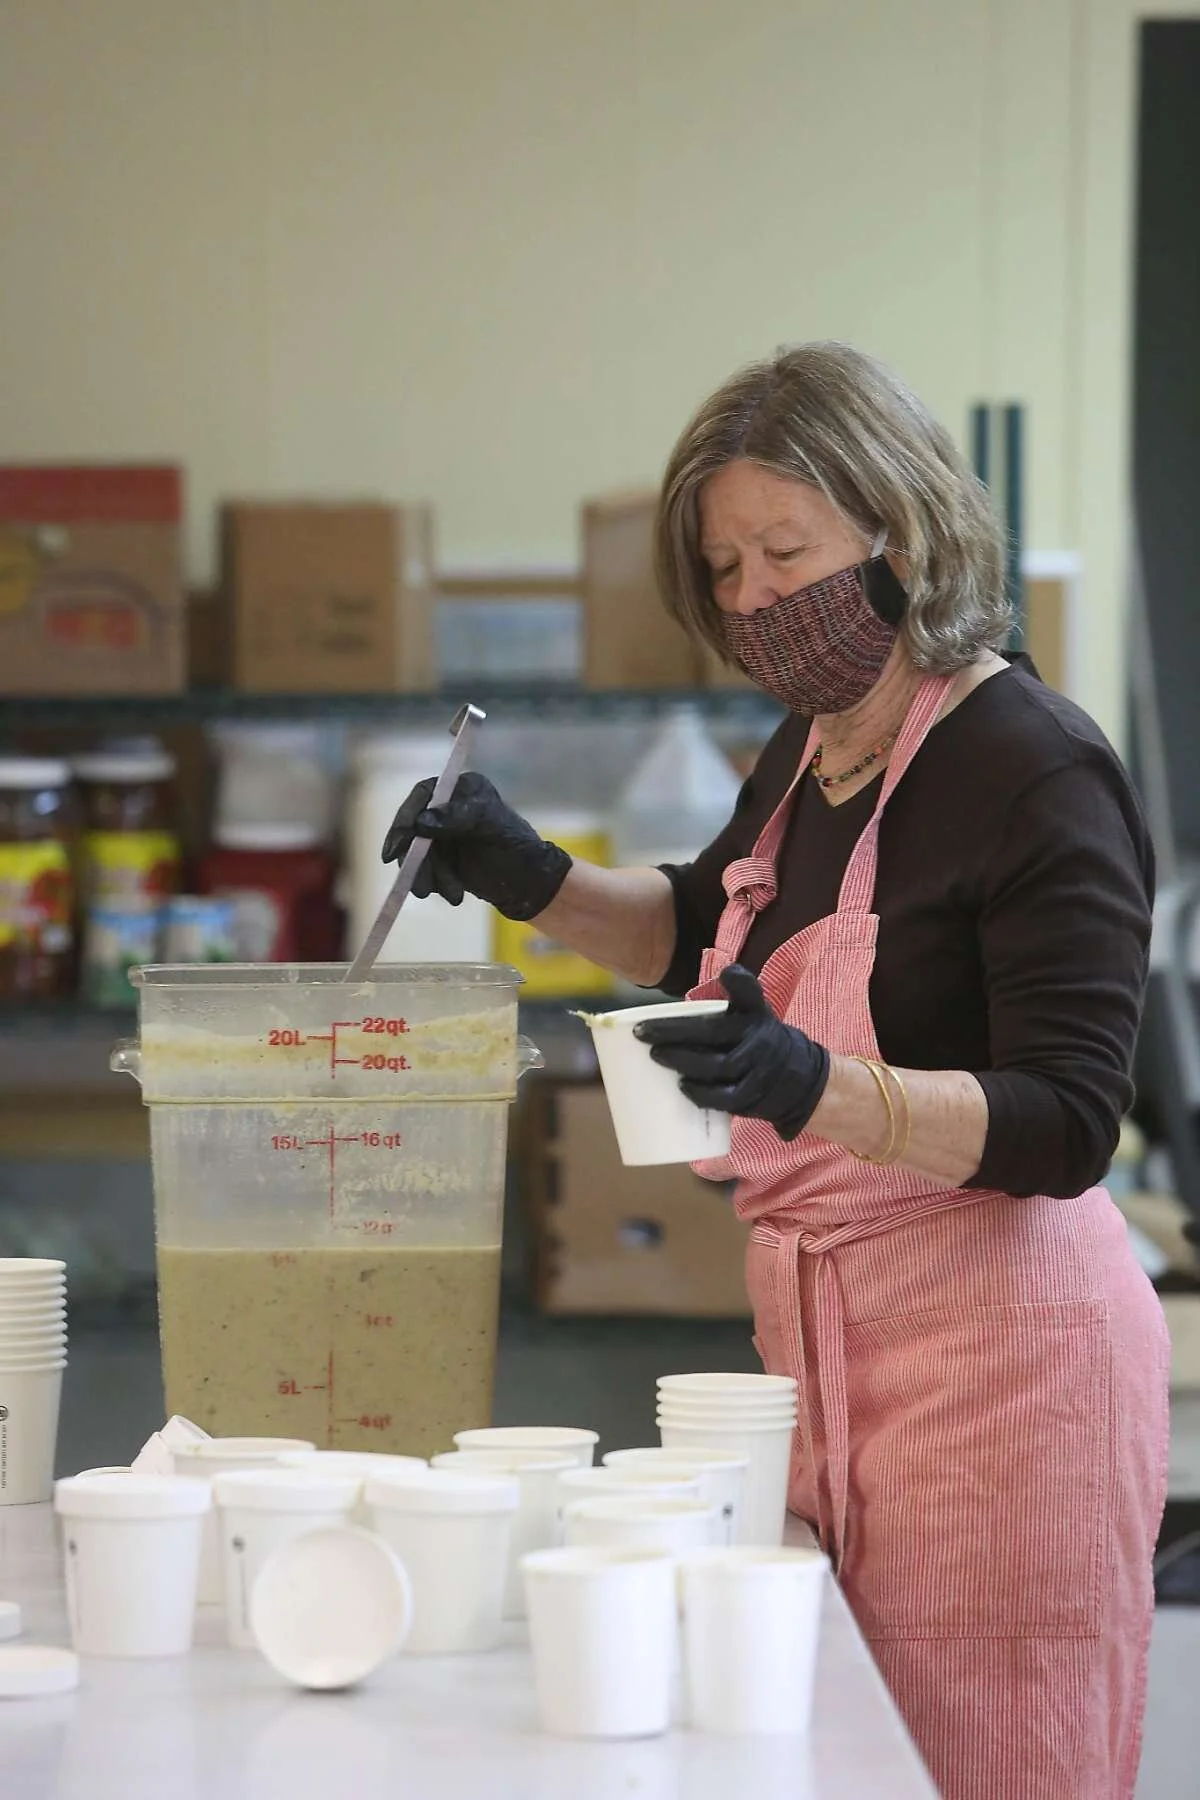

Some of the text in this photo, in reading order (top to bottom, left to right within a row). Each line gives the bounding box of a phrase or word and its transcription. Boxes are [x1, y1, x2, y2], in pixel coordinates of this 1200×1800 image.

[361, 1017, 411, 1036] 22qt.
[268, 1029, 306, 1046] 20L
[362, 1054, 412, 1073] 20qt.
[271, 1135, 304, 1150] 15L
